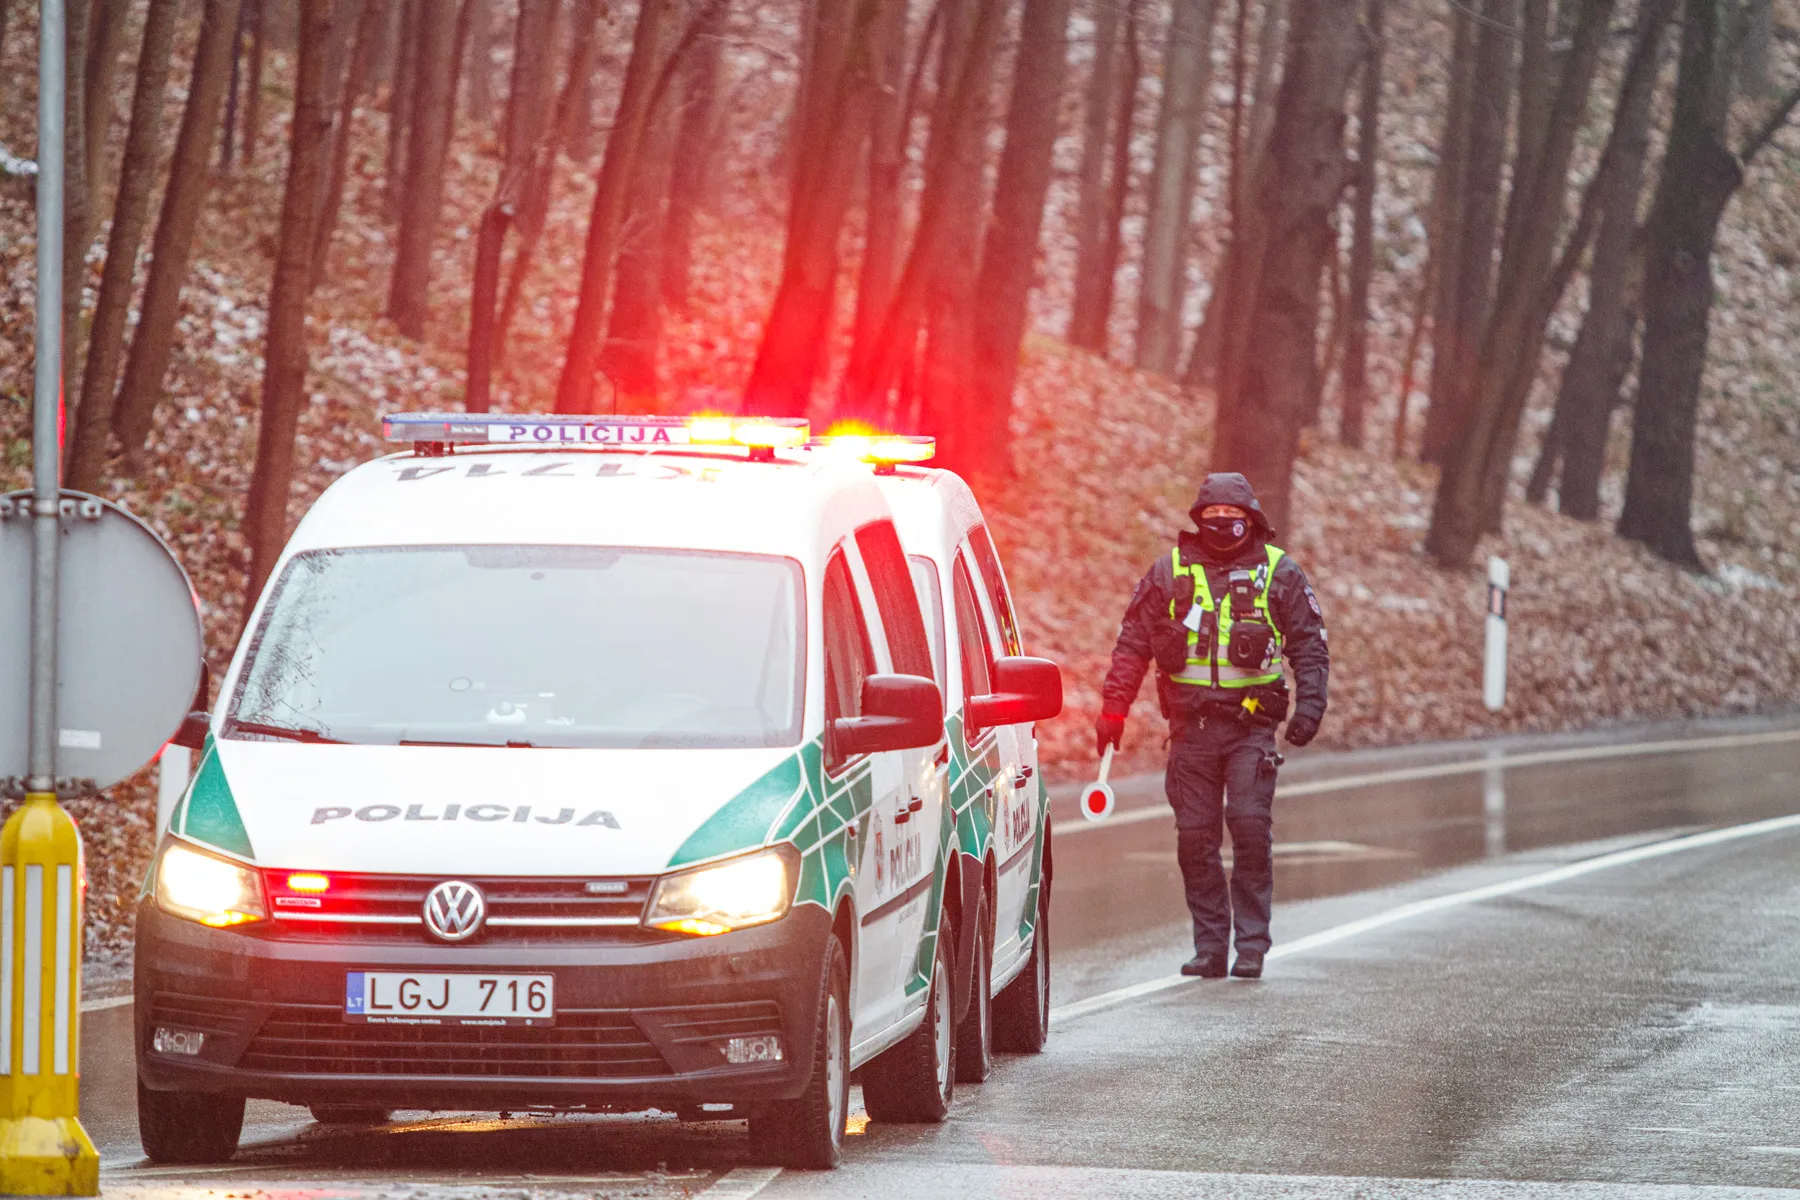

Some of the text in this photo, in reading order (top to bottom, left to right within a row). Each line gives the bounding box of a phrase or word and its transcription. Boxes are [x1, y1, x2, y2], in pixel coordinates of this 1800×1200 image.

[509, 425, 670, 442] POLICIJA
[310, 804, 622, 830] POLICIJA
[347, 996, 364, 1008] LT
[370, 977, 546, 1012] LGJ 716
